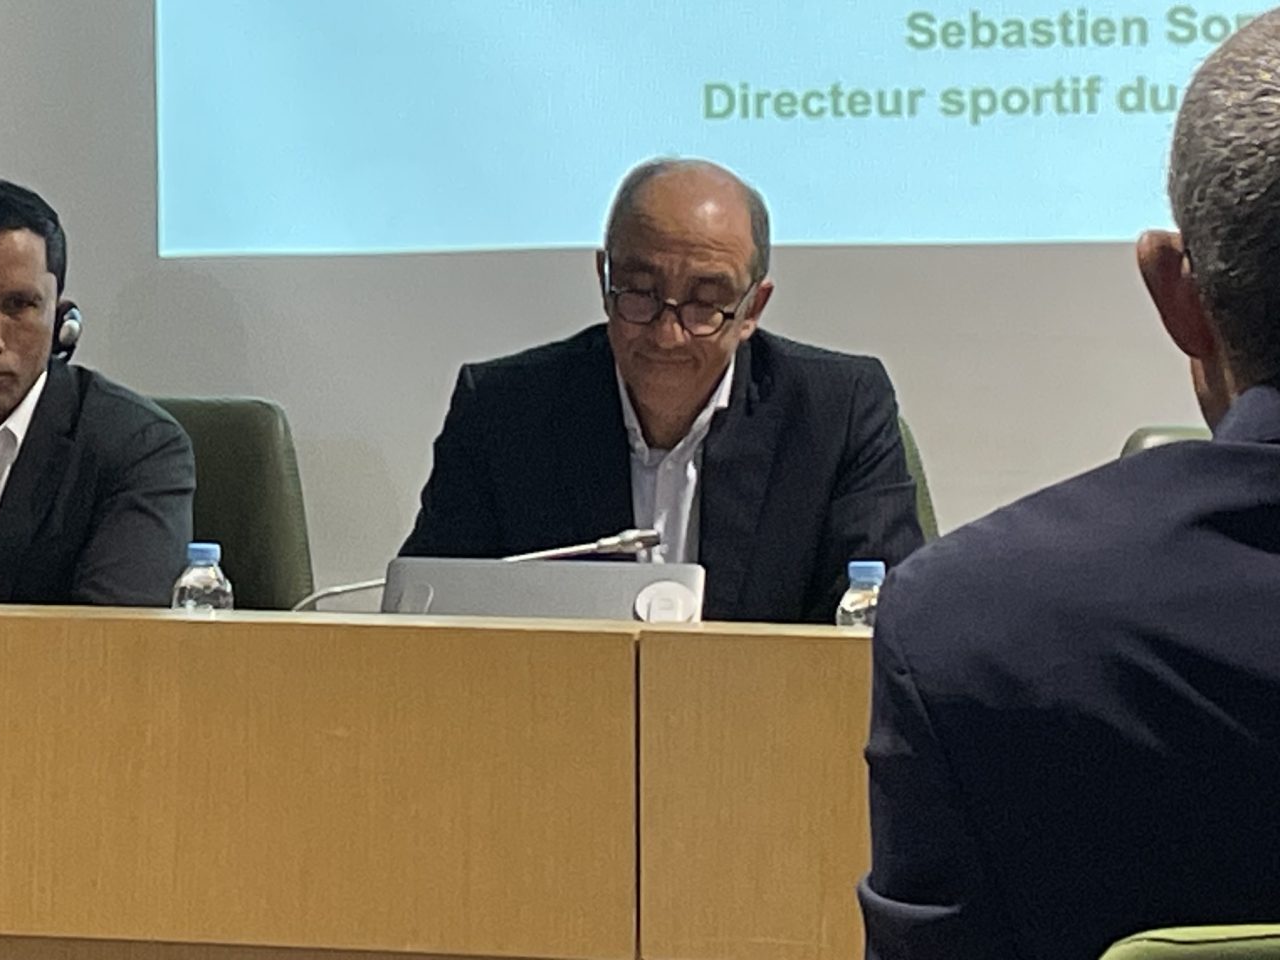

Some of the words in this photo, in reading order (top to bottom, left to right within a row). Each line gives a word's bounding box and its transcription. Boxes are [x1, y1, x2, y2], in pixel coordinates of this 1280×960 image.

[905, 7, 1149, 49] Sebastien
[703, 83, 927, 120] Directeur
[938, 75, 1102, 125] sportif
[1118, 75, 1177, 115] du
